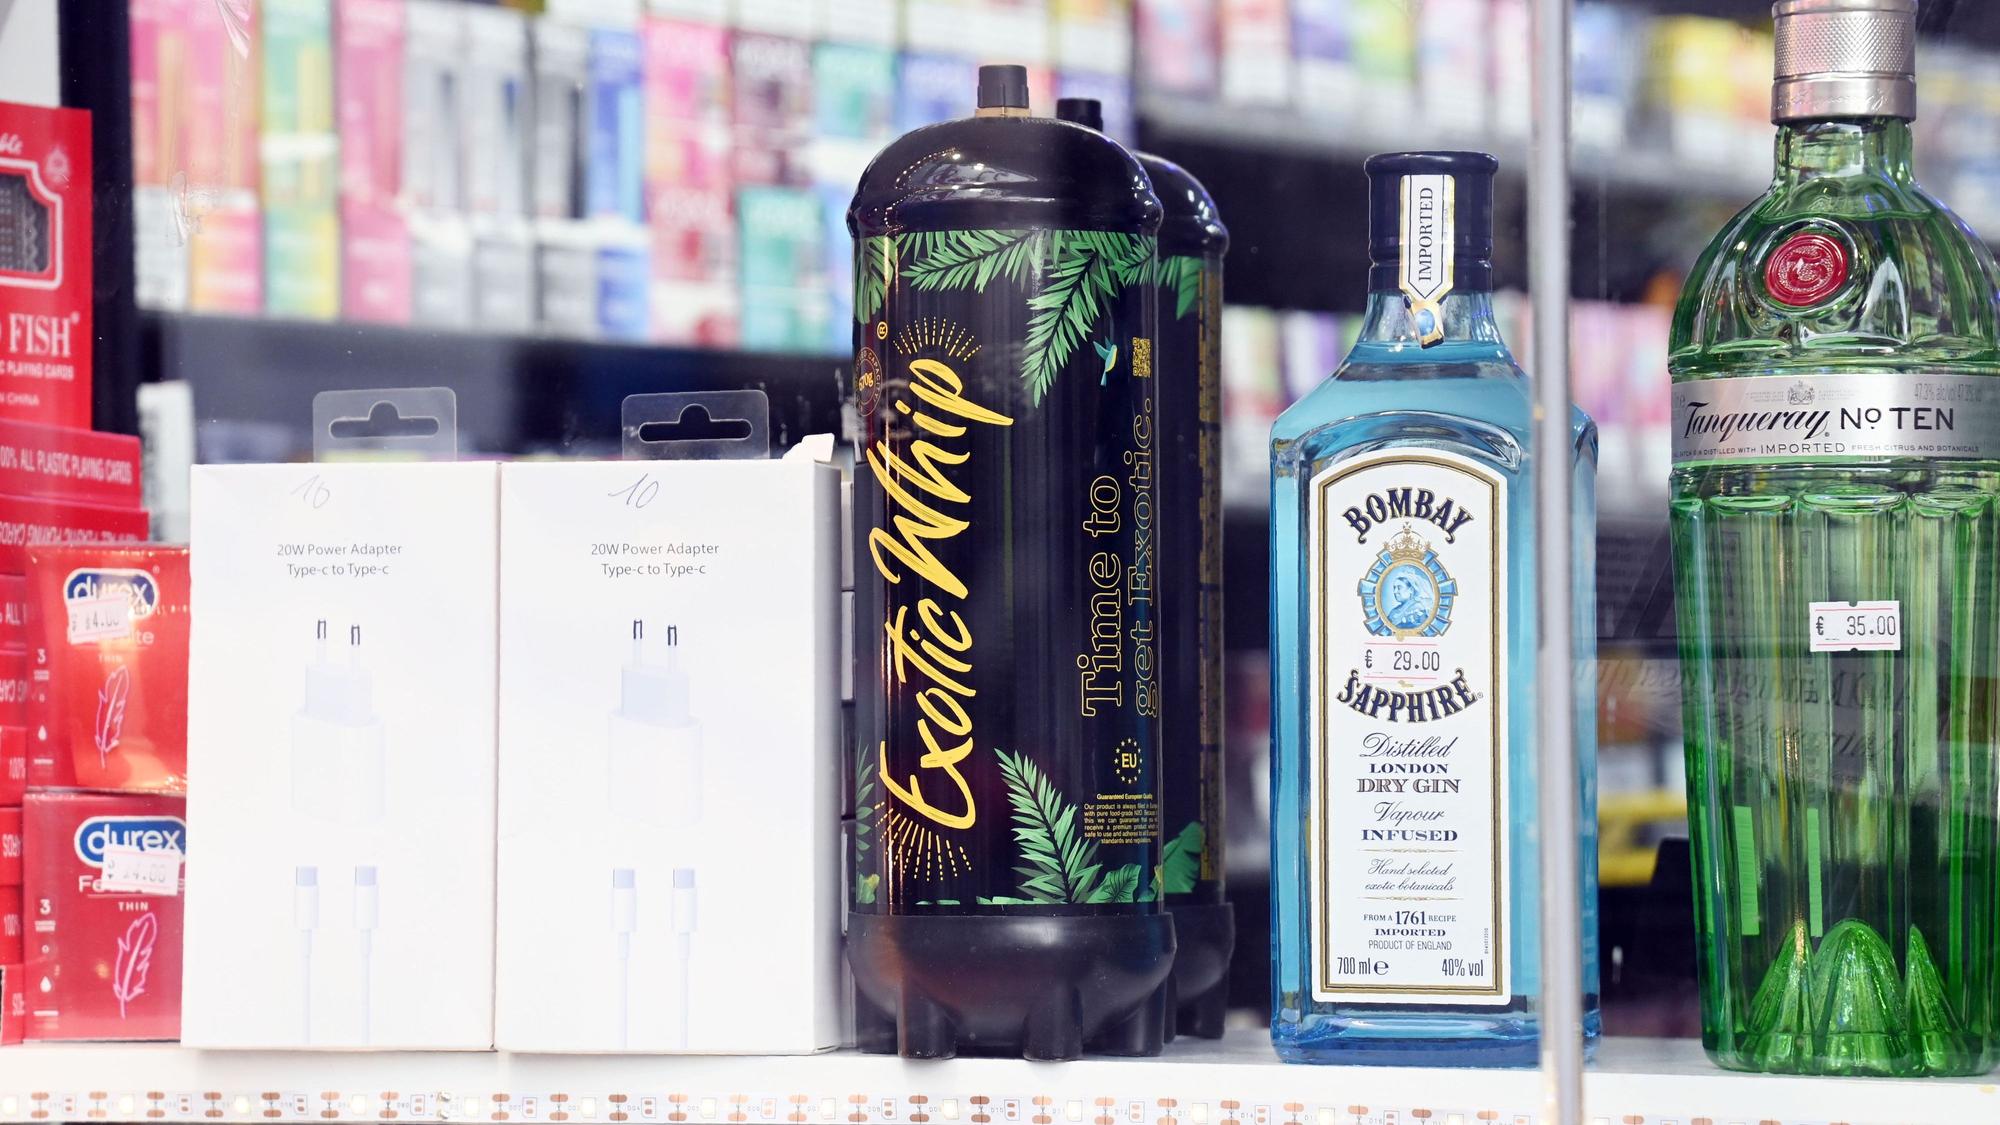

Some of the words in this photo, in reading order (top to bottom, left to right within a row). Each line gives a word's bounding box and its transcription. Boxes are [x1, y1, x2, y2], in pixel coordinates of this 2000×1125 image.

[1418, 187, 1433, 281] IMPORTED
[9, 312, 71, 358] FISH
[1684, 401, 1830, 443] Tanqueray
[1889, 407, 1954, 430] TEN
[1761, 443, 1845, 454] IMPORTED
[37, 450, 70, 477] PLASTIC
[607, 472, 659, 509] 10
[1083, 475, 1121, 538] to
[1124, 397, 1153, 606] Exotic.
[1341, 486, 1474, 544] BOMBAY
[277, 543, 305, 556] 20W
[308, 543, 347, 556] Power
[350, 543, 402, 557] Adapter
[591, 543, 619, 555] 20W
[622, 543, 662, 555] Power
[666, 542, 719, 557] Adapter
[287, 563, 329, 578] Type-c
[332, 564, 344, 575] to
[347, 562, 390, 577] Type-c
[601, 563, 645, 578] Type-c
[647, 564, 660, 575] to
[663, 562, 706, 577] Type-c
[1077, 552, 1121, 717] Time
[1846, 615, 1896, 637] 35.00
[37, 648, 46, 665] 3
[1393, 650, 1440, 671] 29.00
[1130, 620, 1158, 718] get
[1337, 668, 1478, 723] SAPPHIRE
[1359, 732, 1459, 758] Distilled
[1121, 752, 1137, 769] EU
[1370, 763, 1448, 774] LONDON
[1357, 778, 1408, 793] DRY
[1412, 778, 1461, 793] GIN
[1096, 803, 1116, 811] product
[1109, 810, 1134, 818] food-grade
[1373, 801, 1444, 826] Vapour
[1361, 829, 1458, 842] INFUSED
[1367, 858, 1409, 876] Hand
[1408, 861, 1453, 876] selected
[1364, 880, 1397, 890] exotic
[1398, 877, 1456, 891] botanicals
[40, 898, 51, 914] 3
[118, 901, 149, 912] THIN
[1363, 913, 1386, 922] FROM
[1387, 914, 1393, 922] A
[1395, 911, 1426, 925] 1761
[1428, 914, 1456, 922] RECIPE
[1375, 928, 1446, 937] IMPORTED
[1368, 939, 1402, 950] PRODUCT
[1405, 940, 1414, 950] OF
[1417, 940, 1452, 951] ENGLAND
[1337, 957, 1355, 975] 700
[1358, 957, 1370, 975] ml
[1441, 958, 1465, 977] 40%
[1468, 959, 1484, 977] vol
